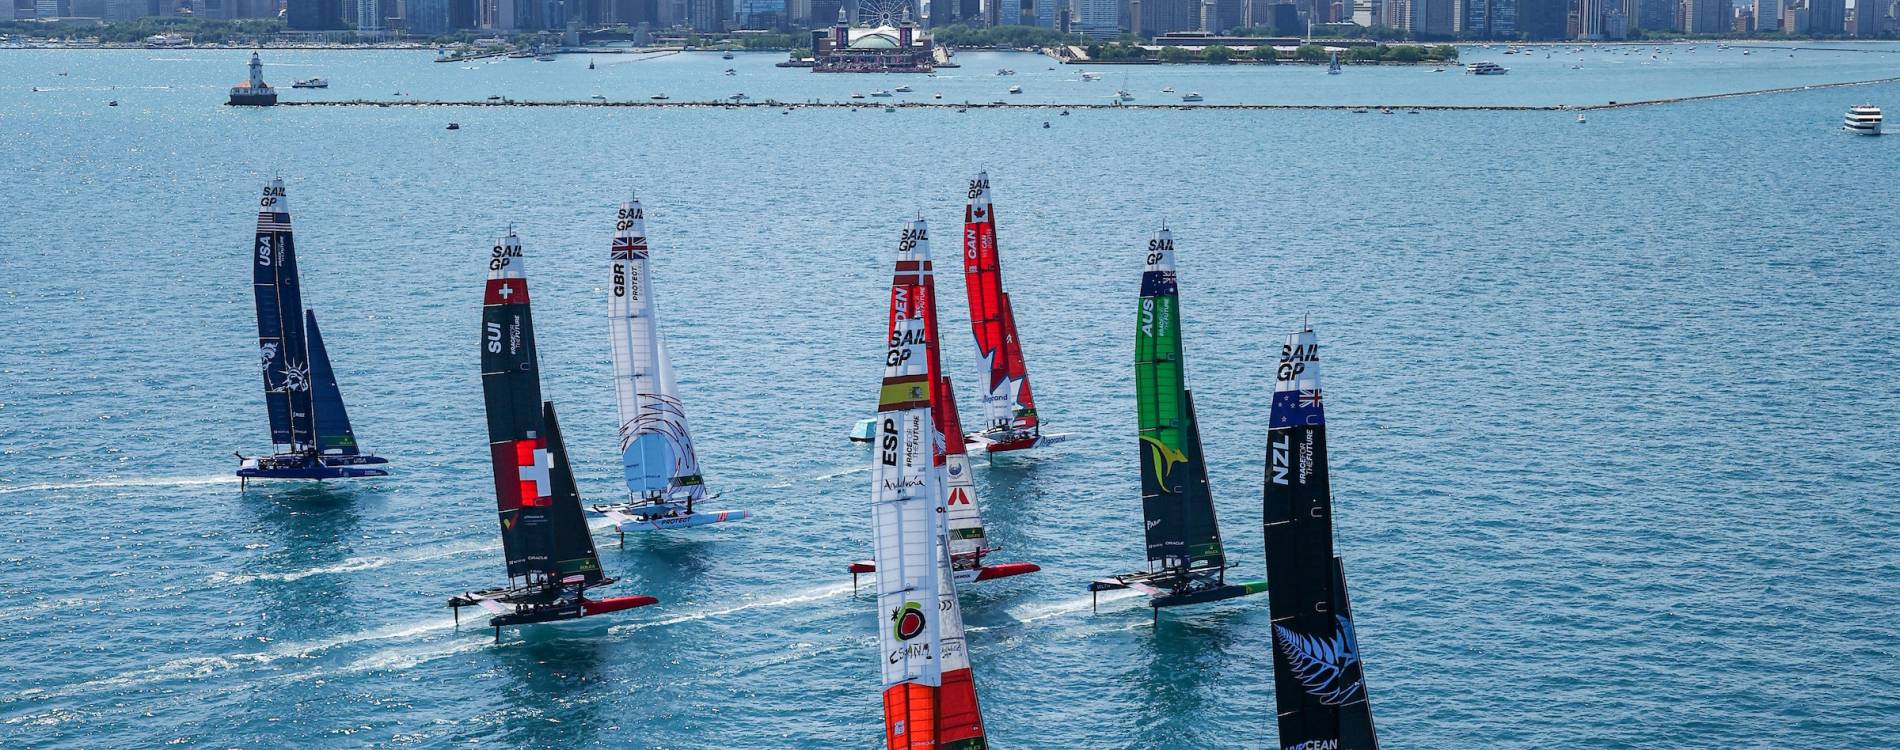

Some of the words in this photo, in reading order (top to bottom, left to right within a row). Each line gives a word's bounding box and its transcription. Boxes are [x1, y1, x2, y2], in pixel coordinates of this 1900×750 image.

[262, 186, 286, 197] SAIL
[969, 180, 990, 189] SAIL
[260, 198, 276, 206] GP
[968, 190, 982, 199] GP
[618, 208, 644, 219] SAIL
[616, 220, 634, 232] GP
[902, 229, 928, 240] SAIL
[260, 236, 270, 266] USA
[492, 245, 523, 258] SAIL
[899, 241, 917, 252] GP
[968, 230, 976, 259] CAN
[1148, 240, 1174, 251] SAIL
[490, 258, 510, 270] GP
[1146, 253, 1163, 265] GP
[614, 264, 624, 298] GBR
[896, 288, 908, 321] DEN
[1142, 299, 1154, 338] AUS
[488, 322, 502, 354] SUI
[890, 329, 926, 348] SAIL
[886, 349, 912, 367] GP
[1280, 344, 1320, 362] SAIL
[1277, 363, 1305, 382] GP
[882, 418, 898, 467] ESP
[1272, 435, 1289, 486] NZL
